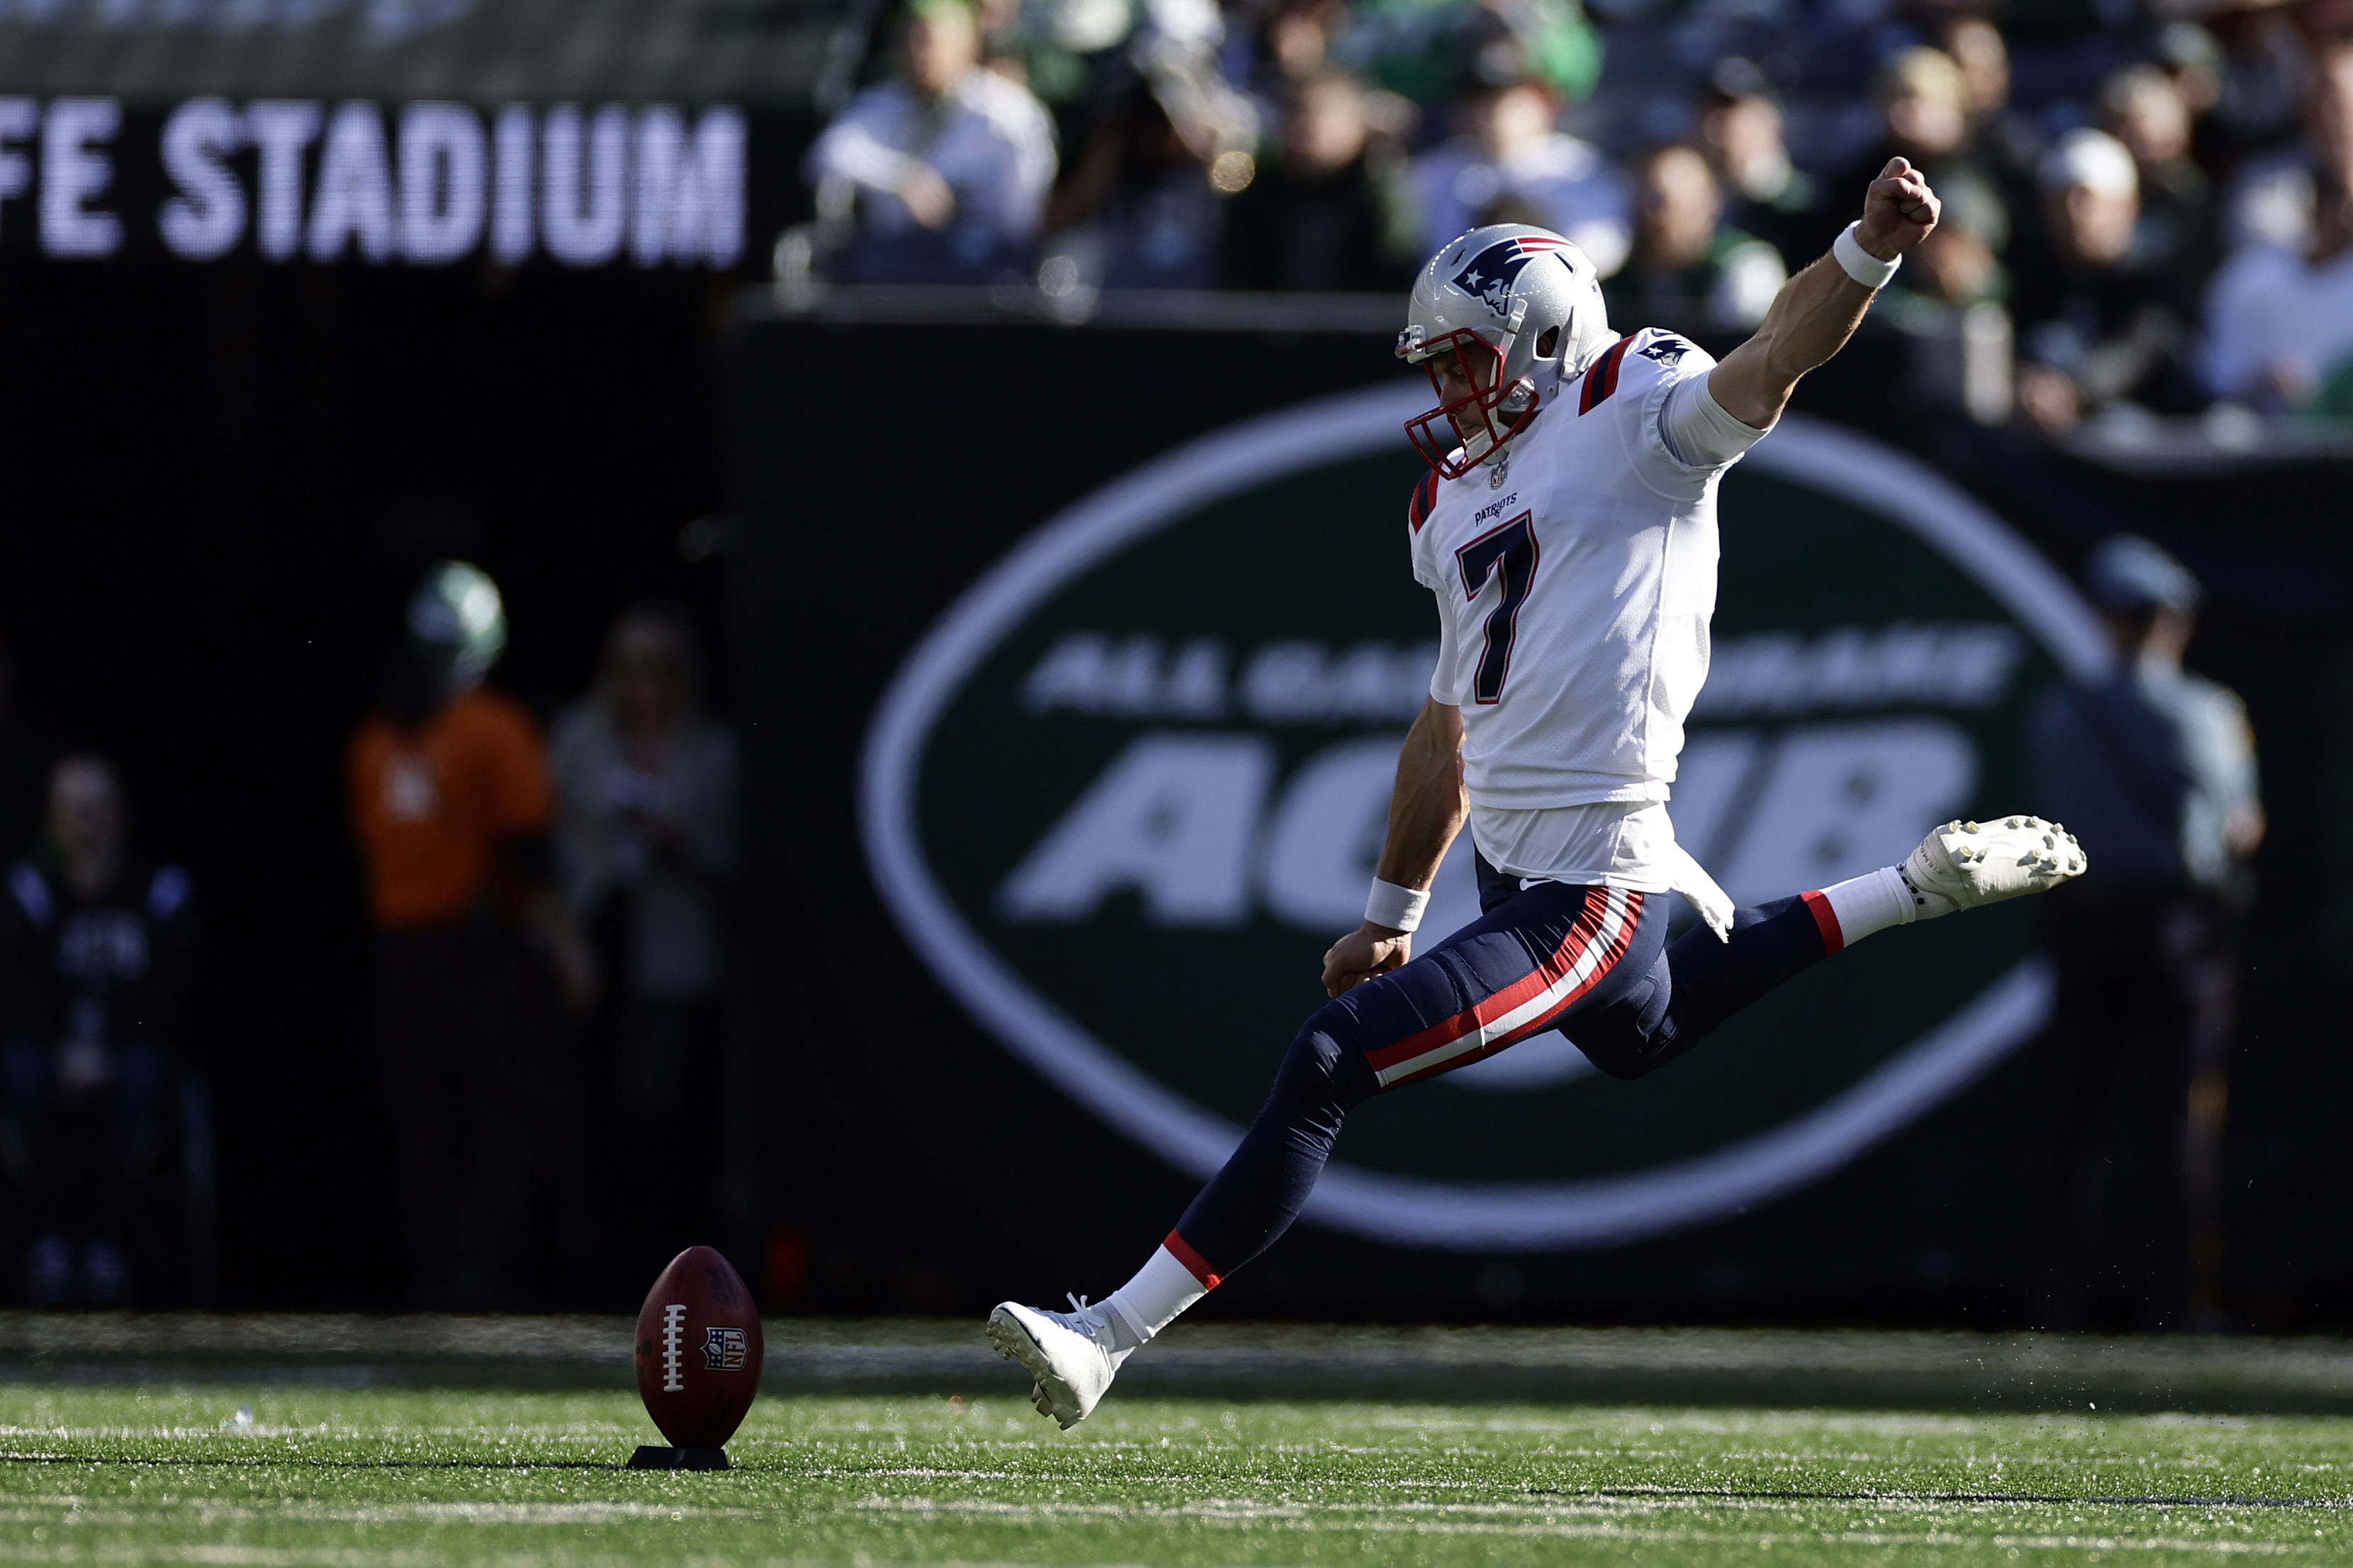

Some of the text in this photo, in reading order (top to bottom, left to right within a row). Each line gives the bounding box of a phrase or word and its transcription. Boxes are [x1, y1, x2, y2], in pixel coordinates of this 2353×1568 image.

[159, 95, 747, 269] STADIUM
[1475, 492, 1517, 527] PATRIOTS
[1455, 509, 1540, 704] 7
[1025, 633, 1226, 714] ALL
[1920, 841, 1943, 874] TIEMP
[724, 1333, 745, 1366] NFL
